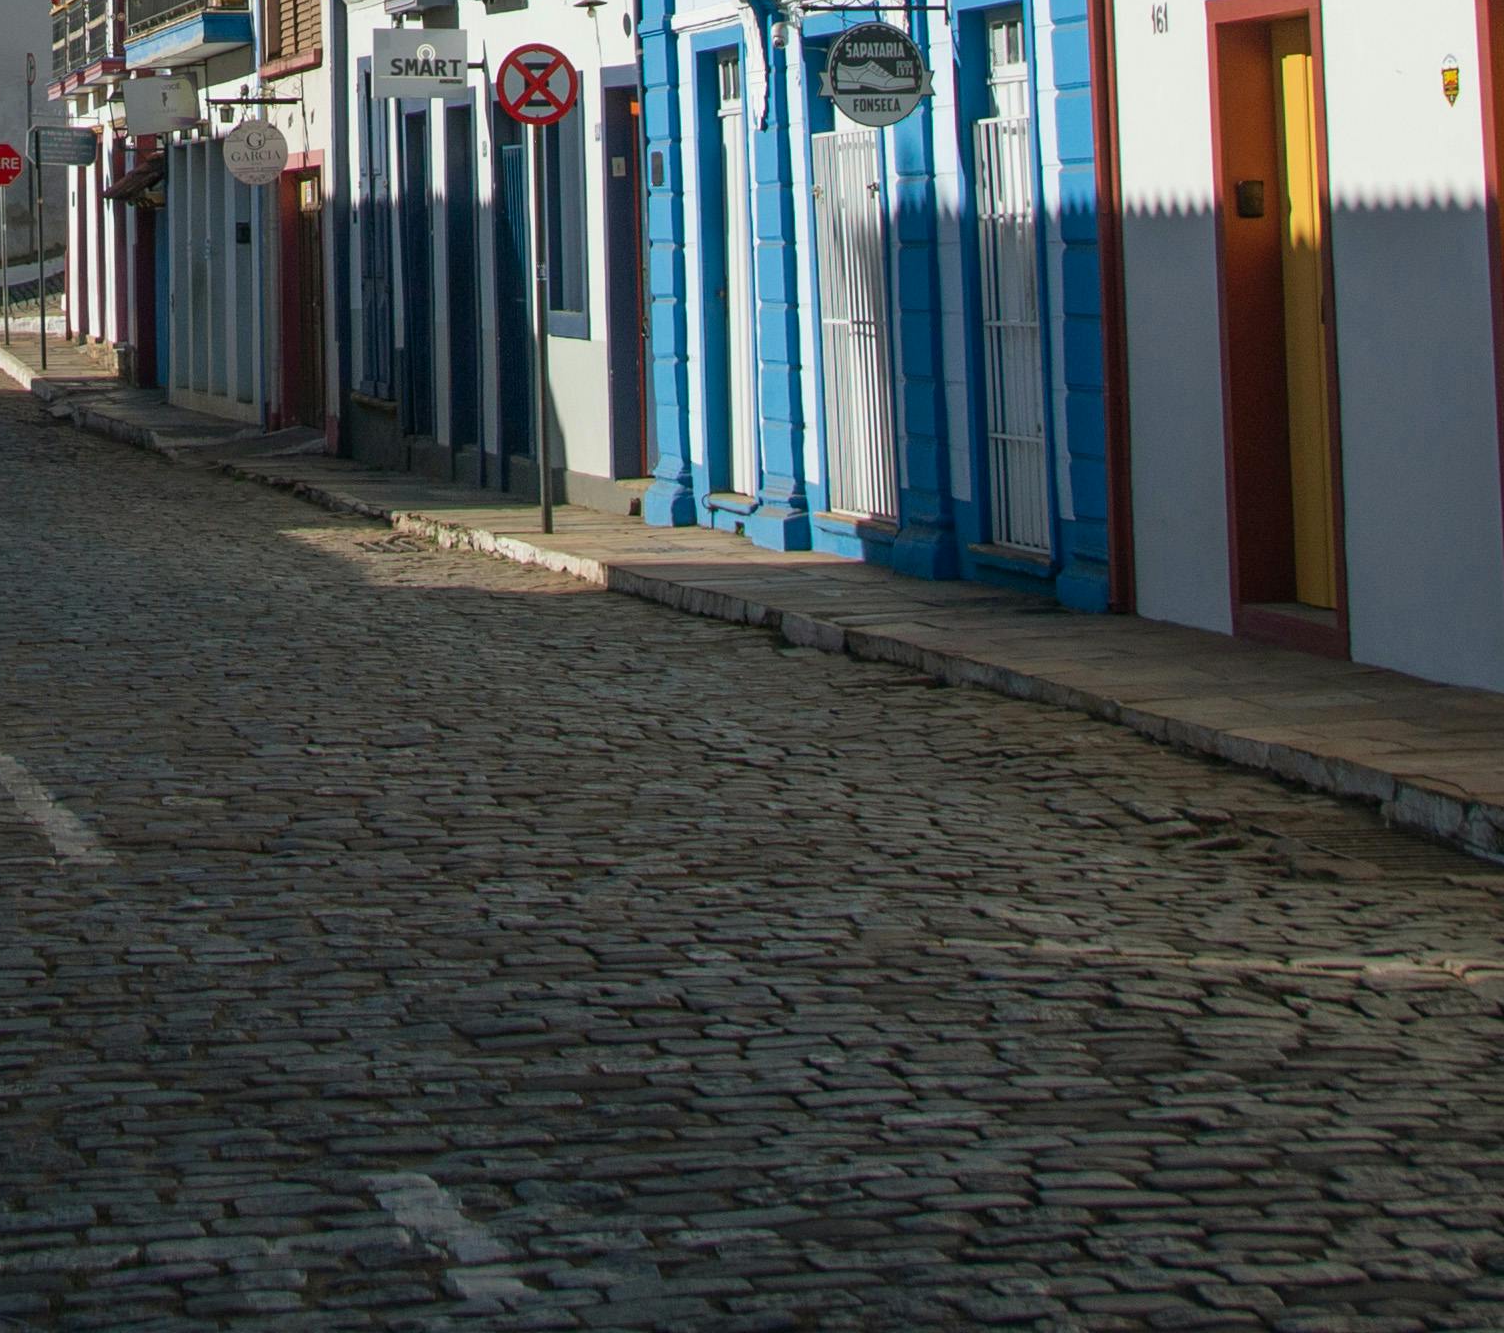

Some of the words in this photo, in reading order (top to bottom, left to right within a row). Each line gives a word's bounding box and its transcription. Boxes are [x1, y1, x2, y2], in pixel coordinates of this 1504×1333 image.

[1151, 1, 1169, 35] 161
[845, 41, 906, 58] SAPATARIA
[390, 58, 462, 77] SMART
[853, 98, 902, 113] FONSECA
[230, 148, 282, 163] GARCIA
